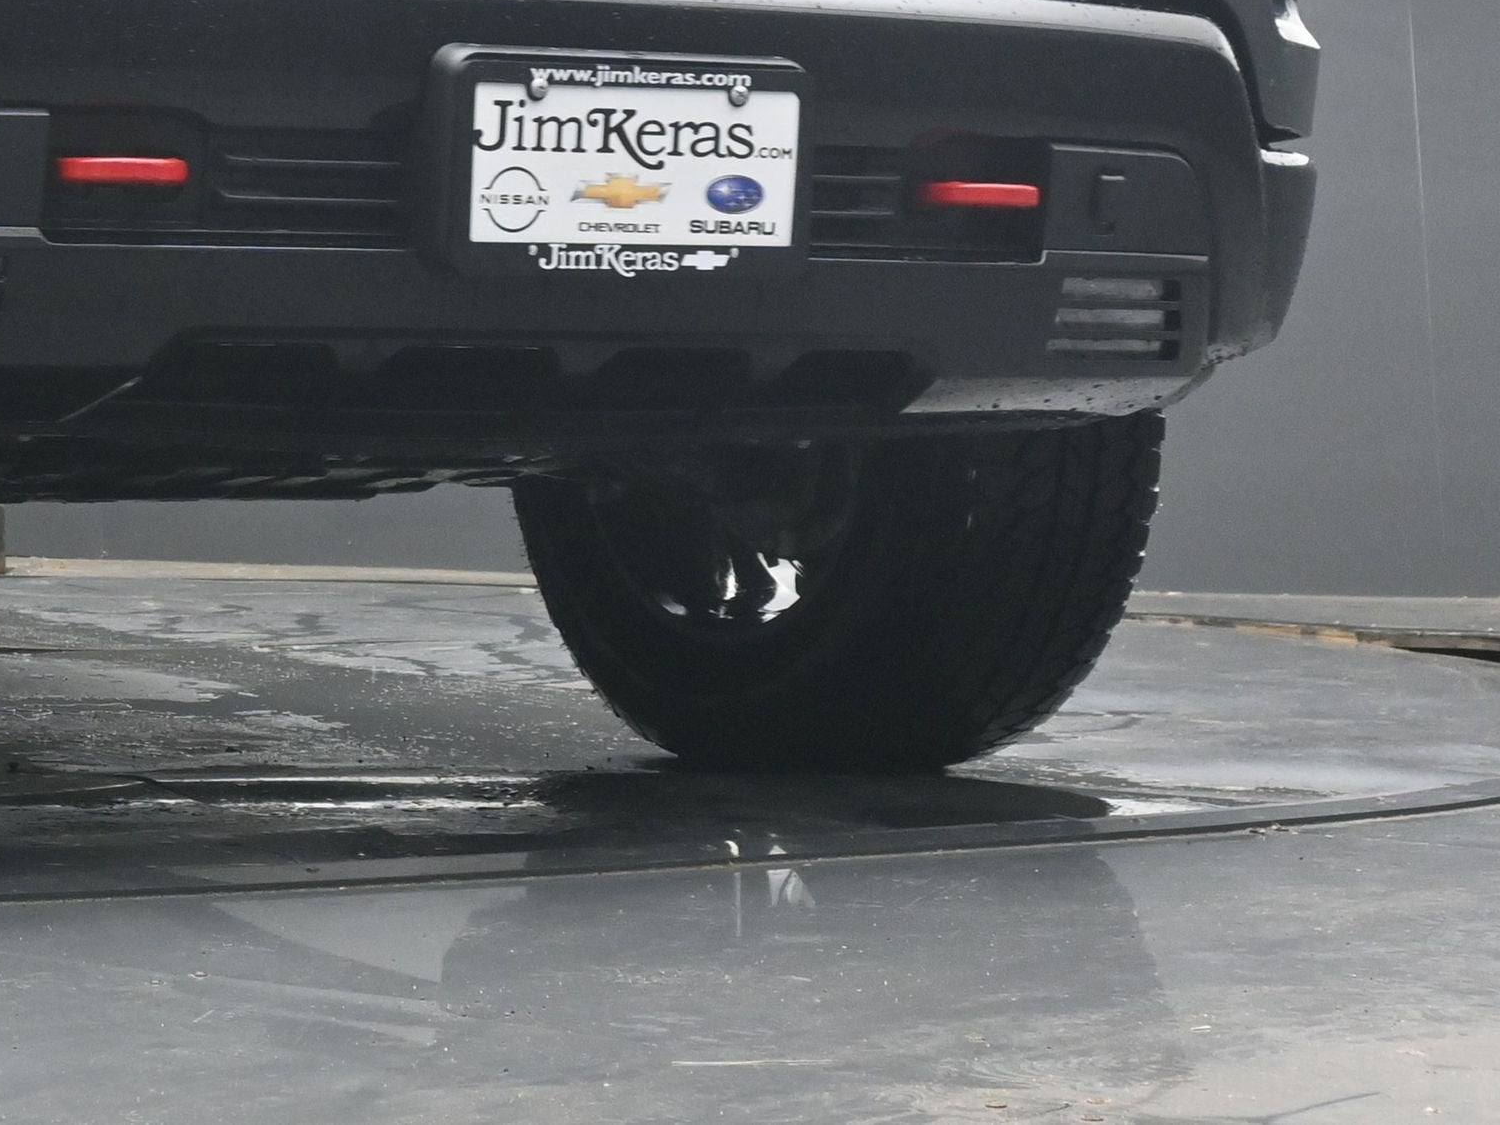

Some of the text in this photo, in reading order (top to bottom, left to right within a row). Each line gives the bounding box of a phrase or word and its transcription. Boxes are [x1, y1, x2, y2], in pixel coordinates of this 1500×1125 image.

[530, 65, 752, 88] www.jimkeras.com
[479, 192, 550, 206] NISSAN
[577, 221, 661, 234] CHEVROLET
[689, 219, 776, 236] SUBARU
